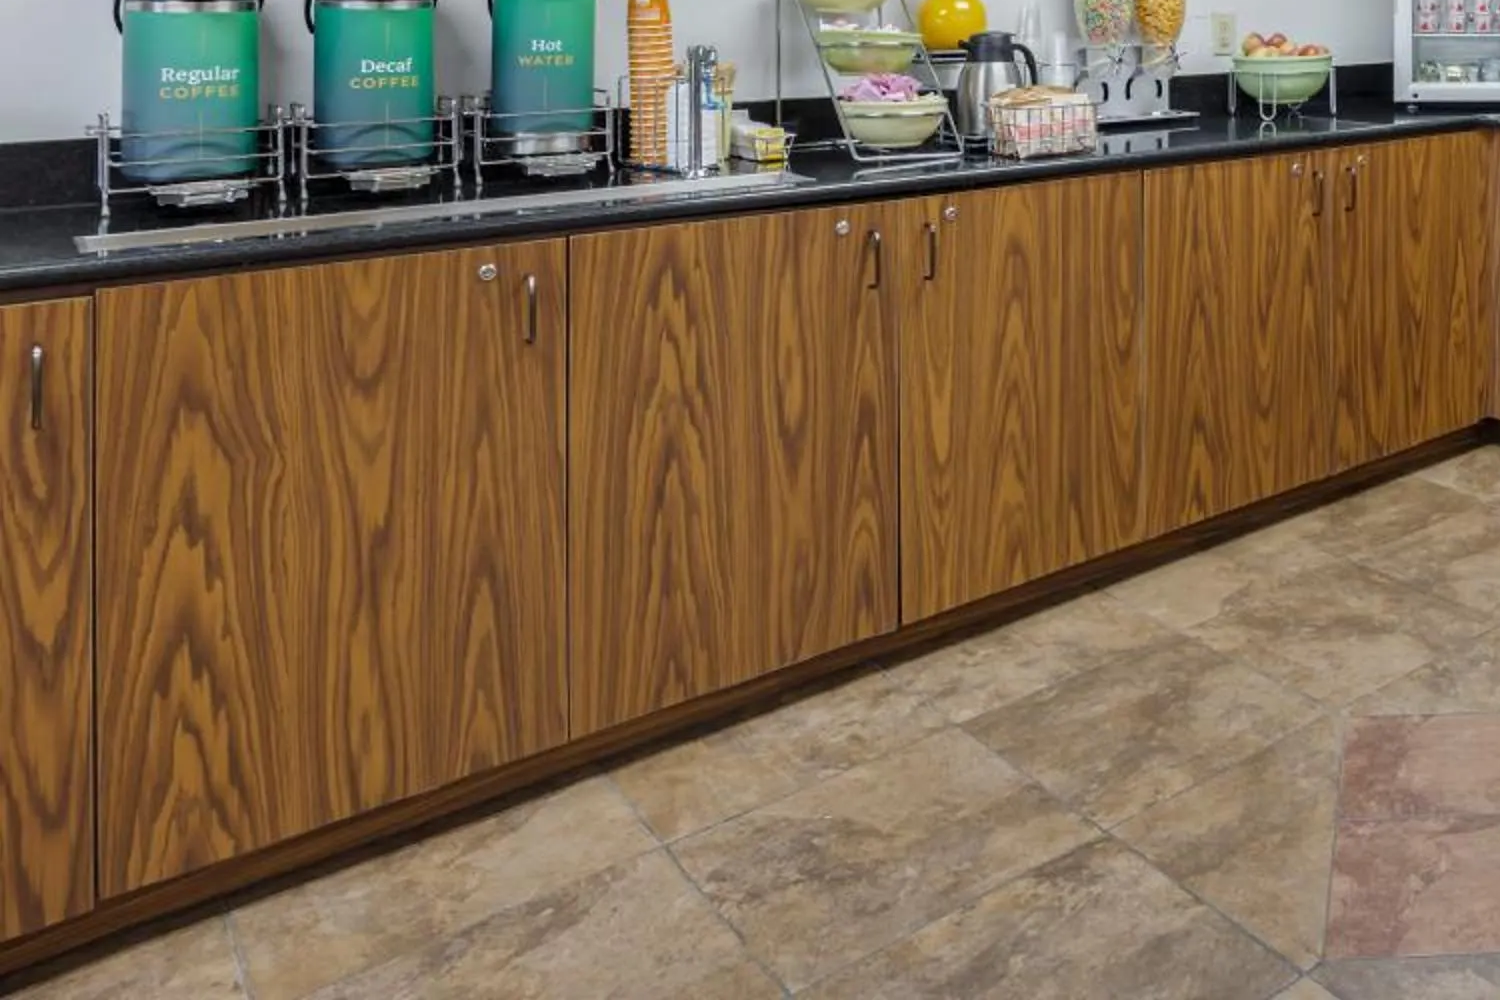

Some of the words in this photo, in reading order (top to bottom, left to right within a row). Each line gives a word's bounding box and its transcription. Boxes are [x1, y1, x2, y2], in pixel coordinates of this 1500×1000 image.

[531, 39, 563, 52] Hot
[360, 57, 413, 73] Decaf
[517, 54, 575, 66] WATER
[160, 64, 240, 85] Regular
[349, 75, 419, 89] COFFEE
[159, 85, 239, 99] COFFEE
